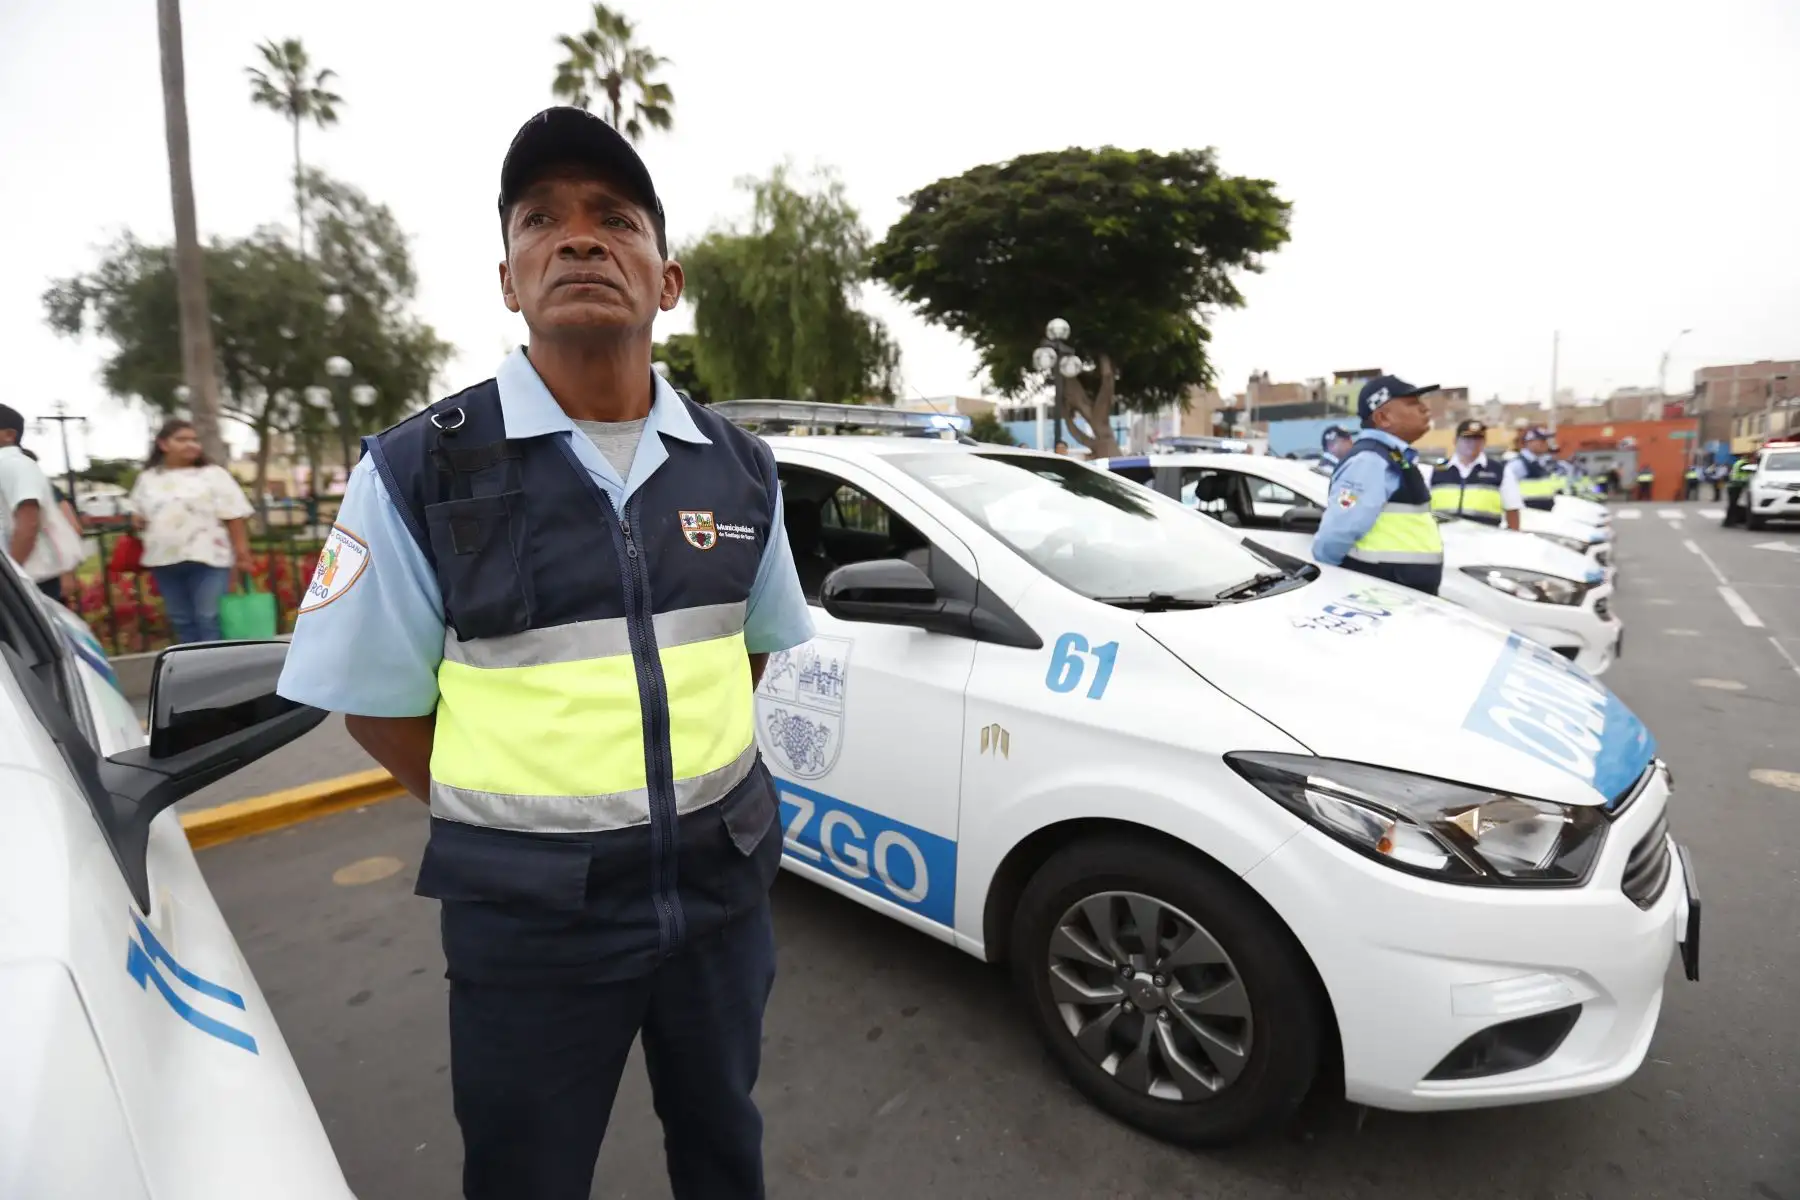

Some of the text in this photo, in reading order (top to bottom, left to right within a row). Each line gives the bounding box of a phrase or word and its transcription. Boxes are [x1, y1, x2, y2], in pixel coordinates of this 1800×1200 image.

[716, 523, 755, 534] Municipalidad
[1045, 632, 1120, 700] 61
[126, 904, 260, 1056] 71
